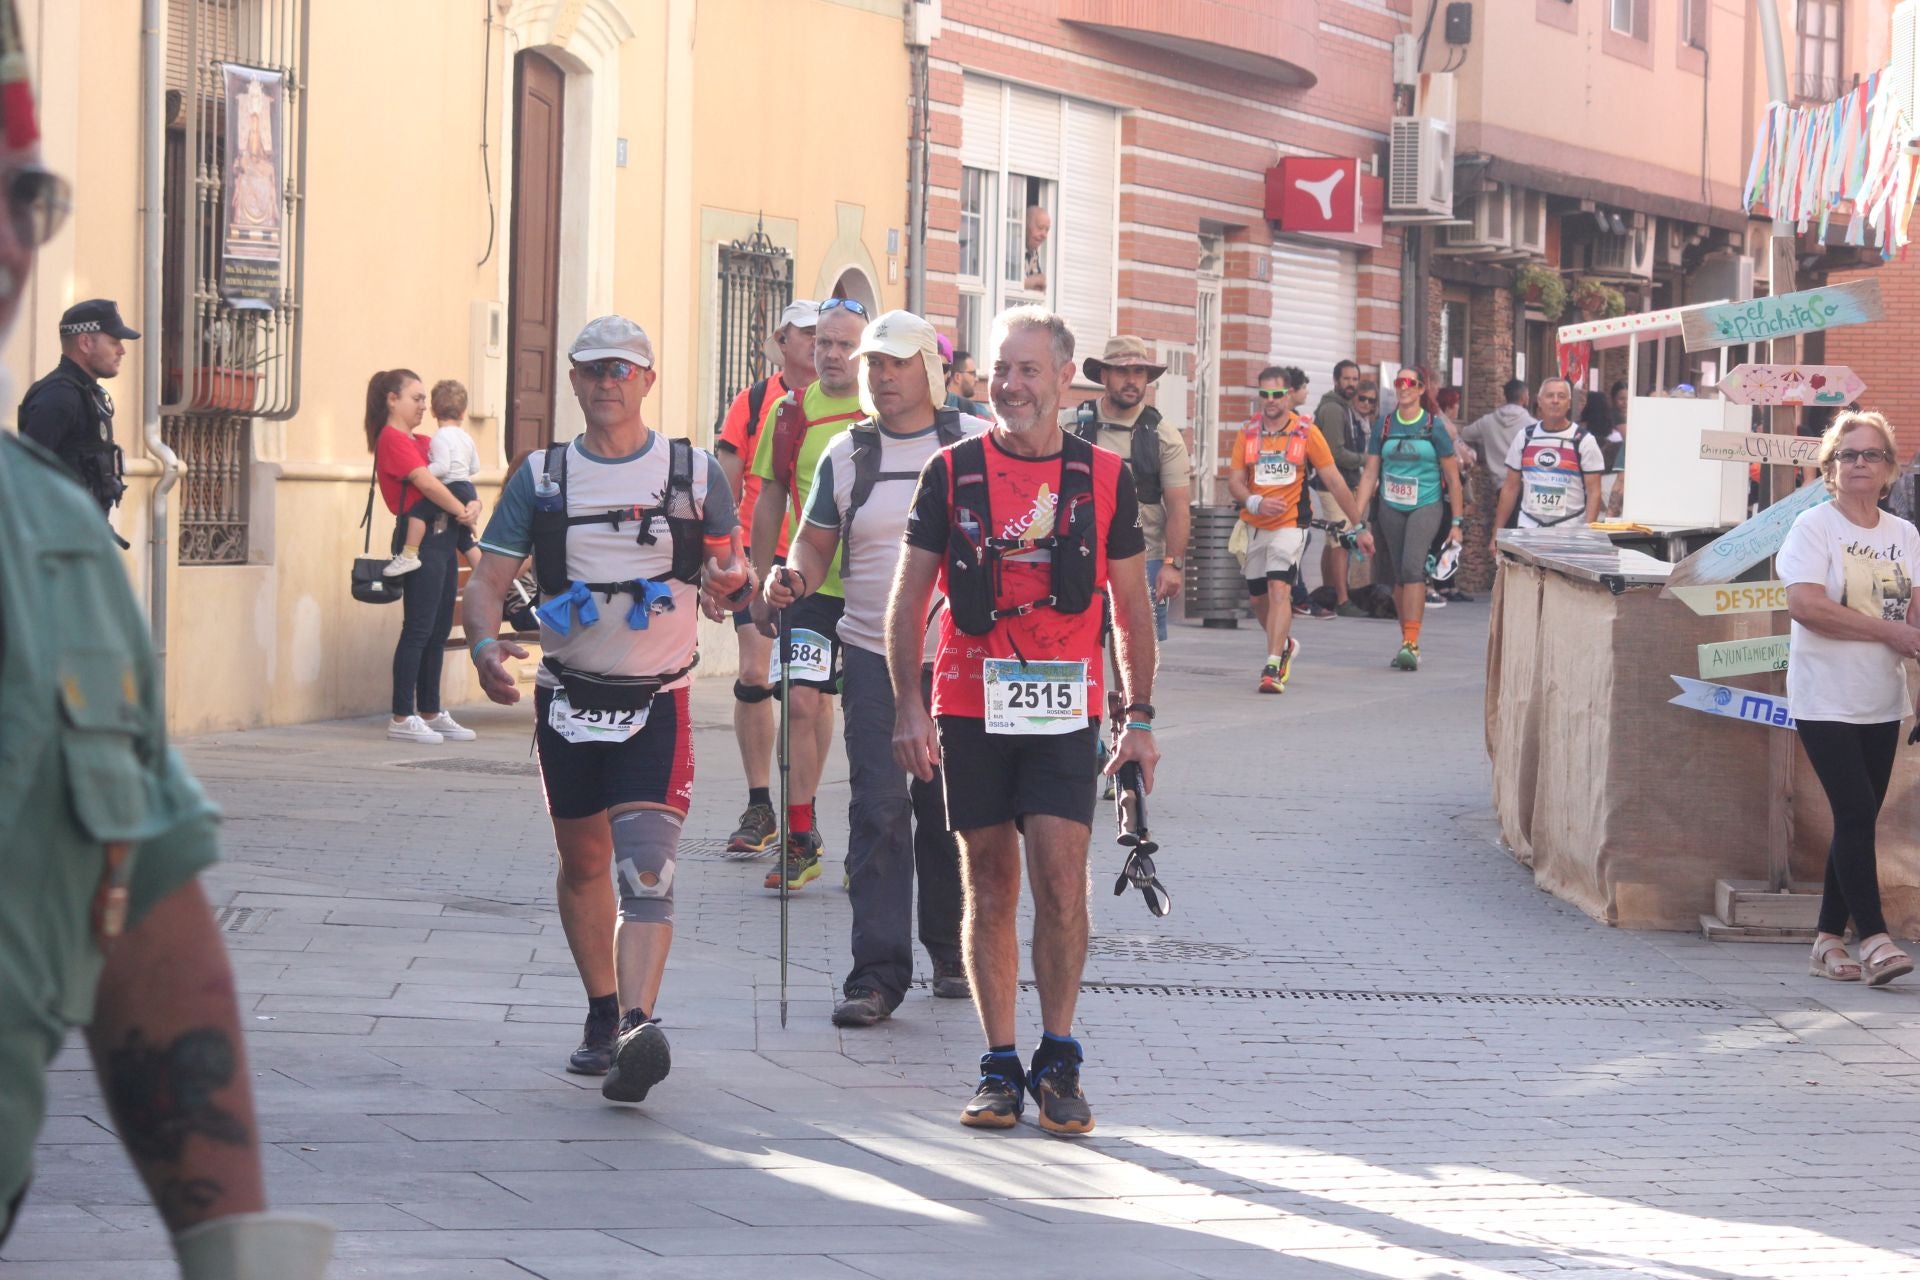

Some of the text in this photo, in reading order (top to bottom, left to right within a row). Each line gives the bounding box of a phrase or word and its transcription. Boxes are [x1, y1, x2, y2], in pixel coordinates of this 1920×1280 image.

[1536, 494, 1561, 506] 1347
[1773, 657, 1789, 670] de
[1008, 682, 1072, 709] 2515
